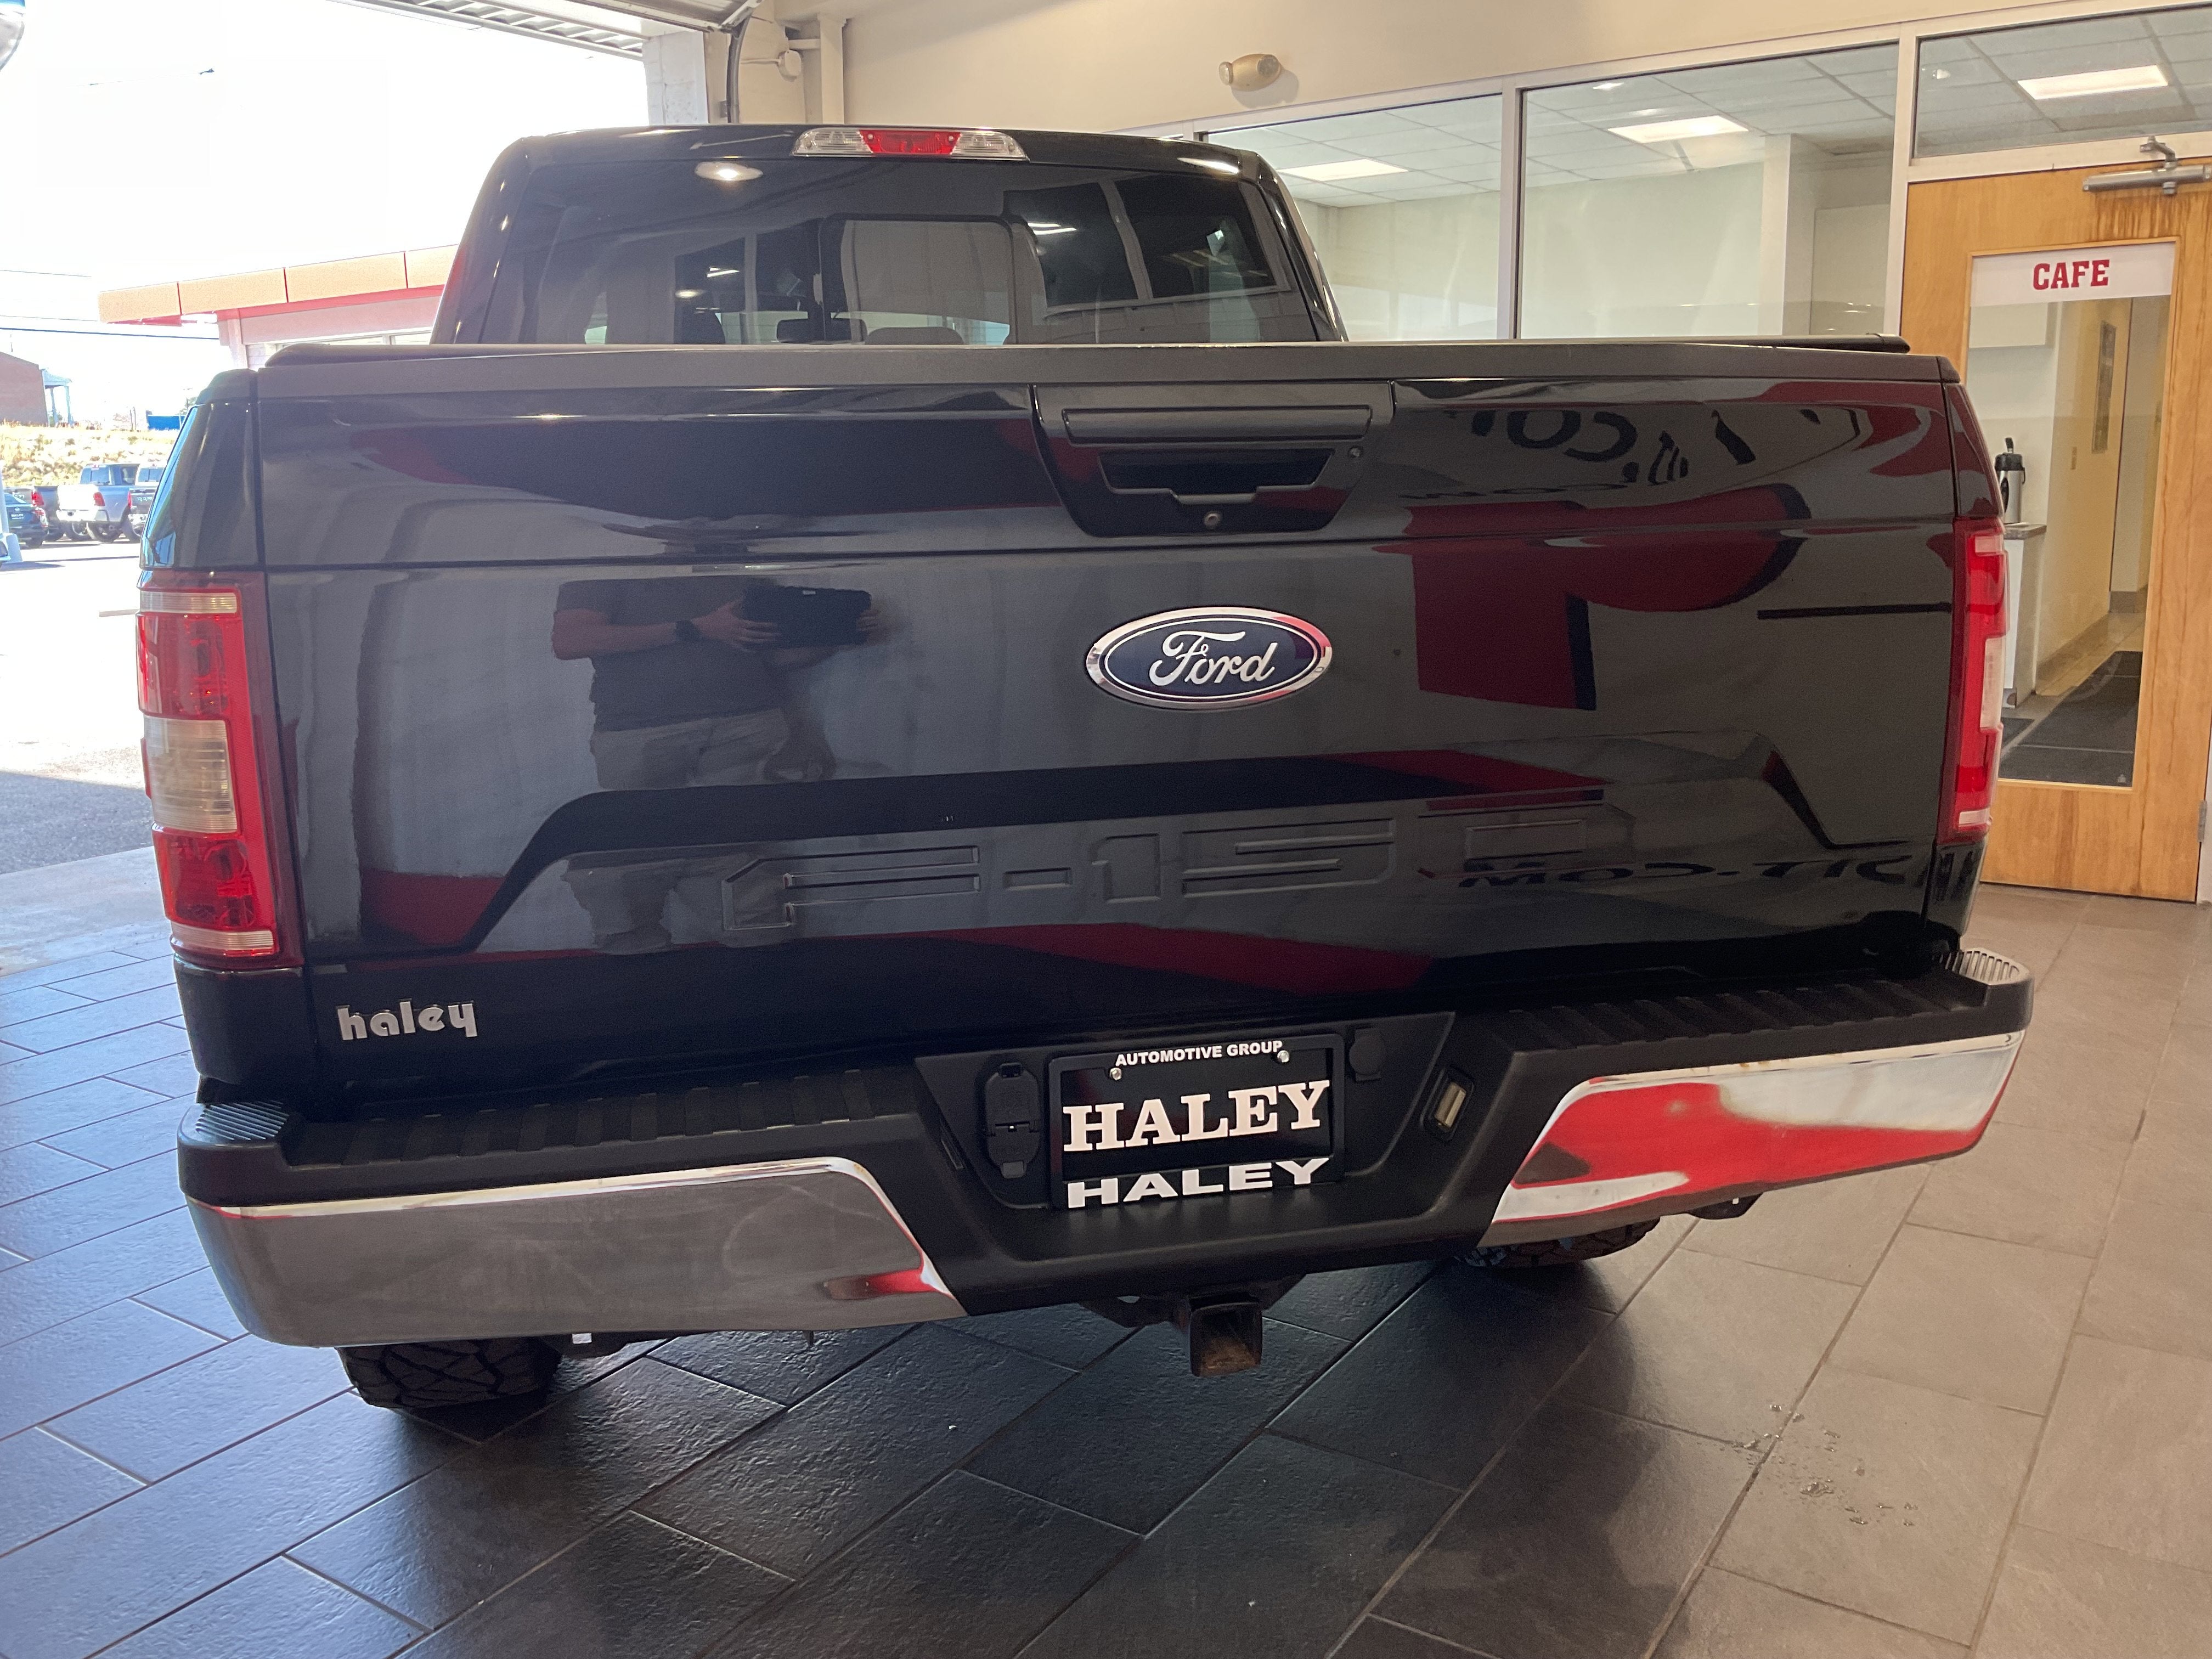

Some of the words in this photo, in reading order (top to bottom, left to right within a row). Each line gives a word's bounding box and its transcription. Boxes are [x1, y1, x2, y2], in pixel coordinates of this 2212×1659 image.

[2033, 259, 2110, 290] CAFE
[1149, 630, 1278, 686] Ford
[722, 803, 1636, 932] F-150
[337, 1001, 478, 1041] haley
[1115, 1045, 1223, 1066] AUTOMOTIVE
[1226, 1040, 1283, 1057] GROUP
[1063, 1079, 1330, 1152] HALEY
[1067, 1157, 1330, 1209] HALEY
